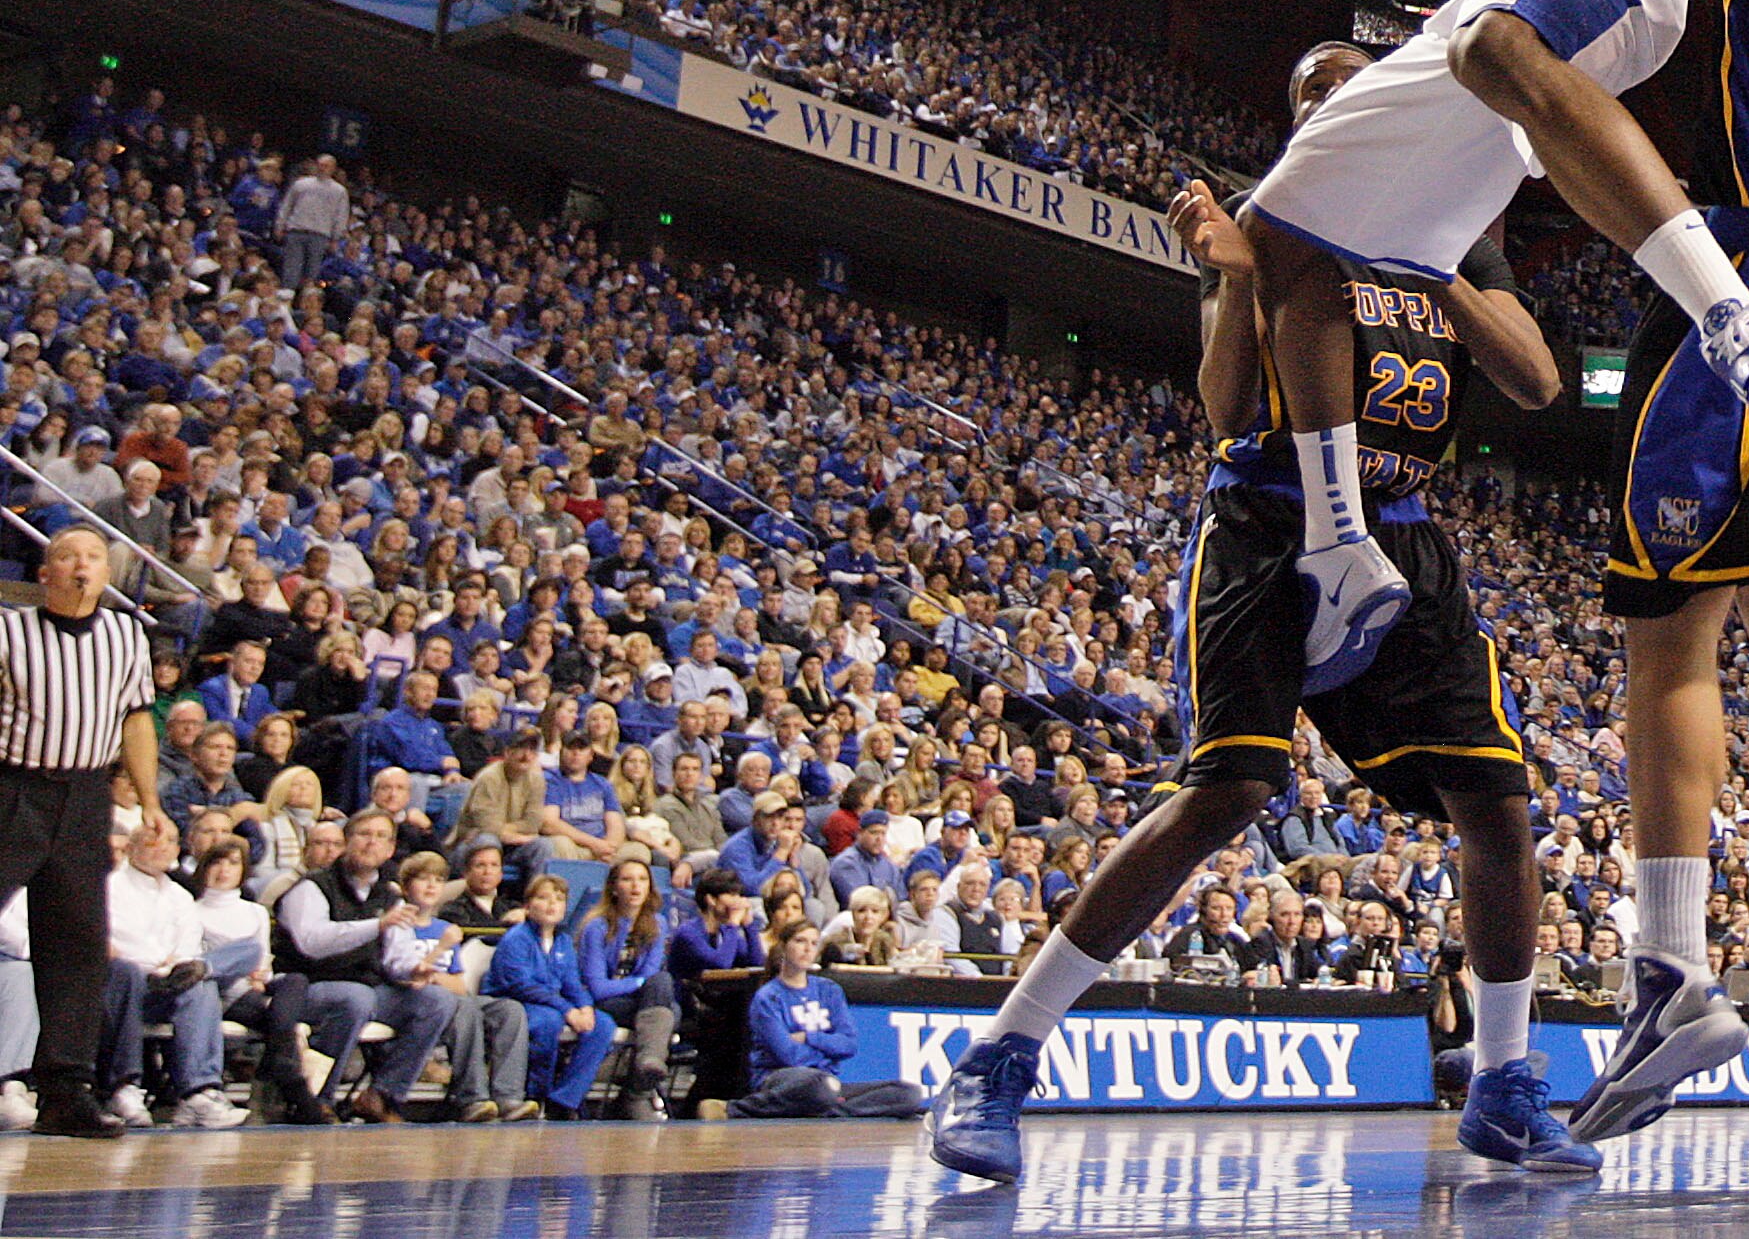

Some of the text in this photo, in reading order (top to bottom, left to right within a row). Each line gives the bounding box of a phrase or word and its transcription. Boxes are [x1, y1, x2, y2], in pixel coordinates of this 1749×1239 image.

[798, 101, 1067, 226] WHITAKER
[1361, 350, 1451, 432] 23
[889, 1011, 1360, 1101] KNTUCKY
